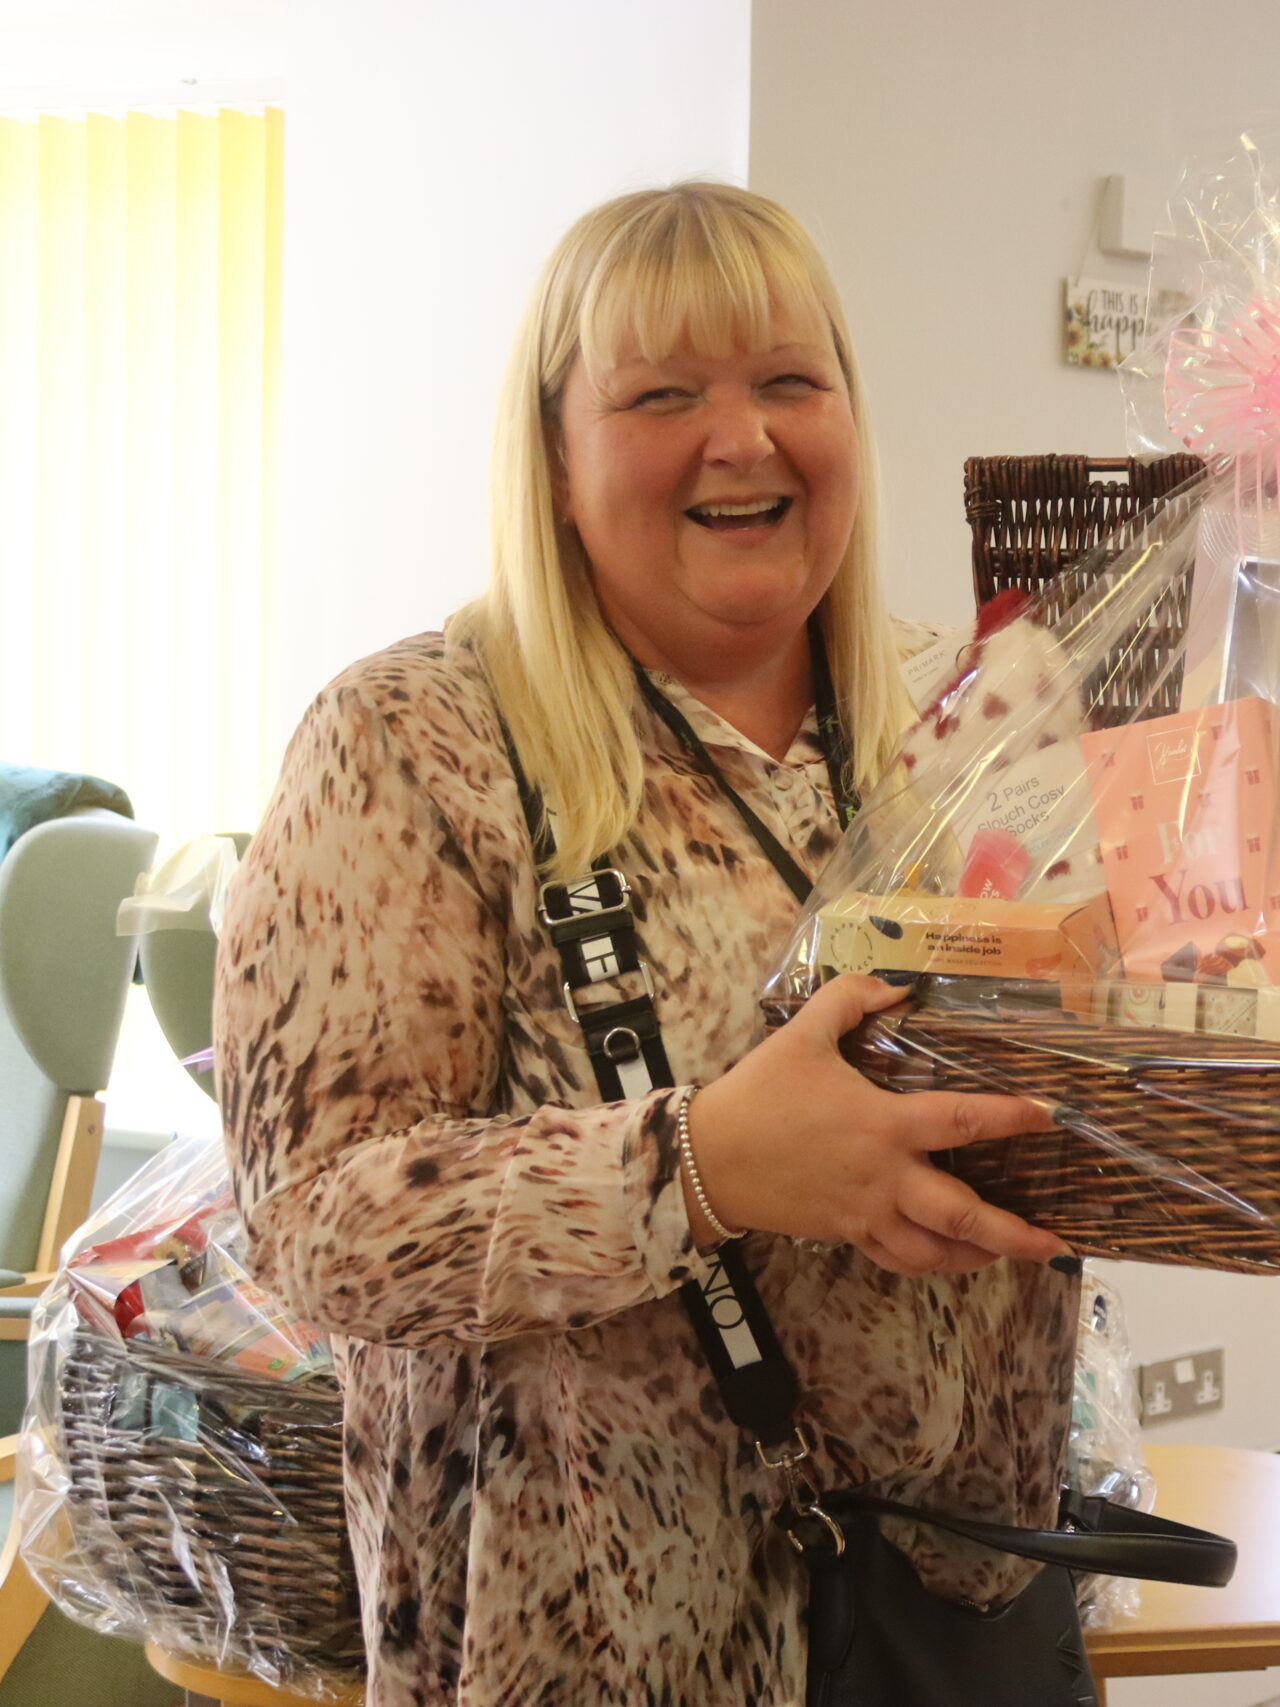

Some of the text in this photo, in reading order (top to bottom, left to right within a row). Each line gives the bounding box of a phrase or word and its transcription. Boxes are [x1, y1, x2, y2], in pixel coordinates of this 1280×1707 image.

[1101, 289, 1125, 313] THIS
[1129, 293, 1139, 315] IS
[907, 649, 945, 676] PRIMARK
[986, 776, 1041, 812] 2 Pairs
[1005, 811, 1050, 837] Socks
[1156, 820, 1224, 864] For
[1148, 868, 1251, 926] You
[829, 921, 865, 941] HAPPY
[925, 932, 1003, 944] Happiness is
[841, 954, 875, 972] PLACE
[945, 944, 981, 953] inside
[981, 946, 1002, 956] job
